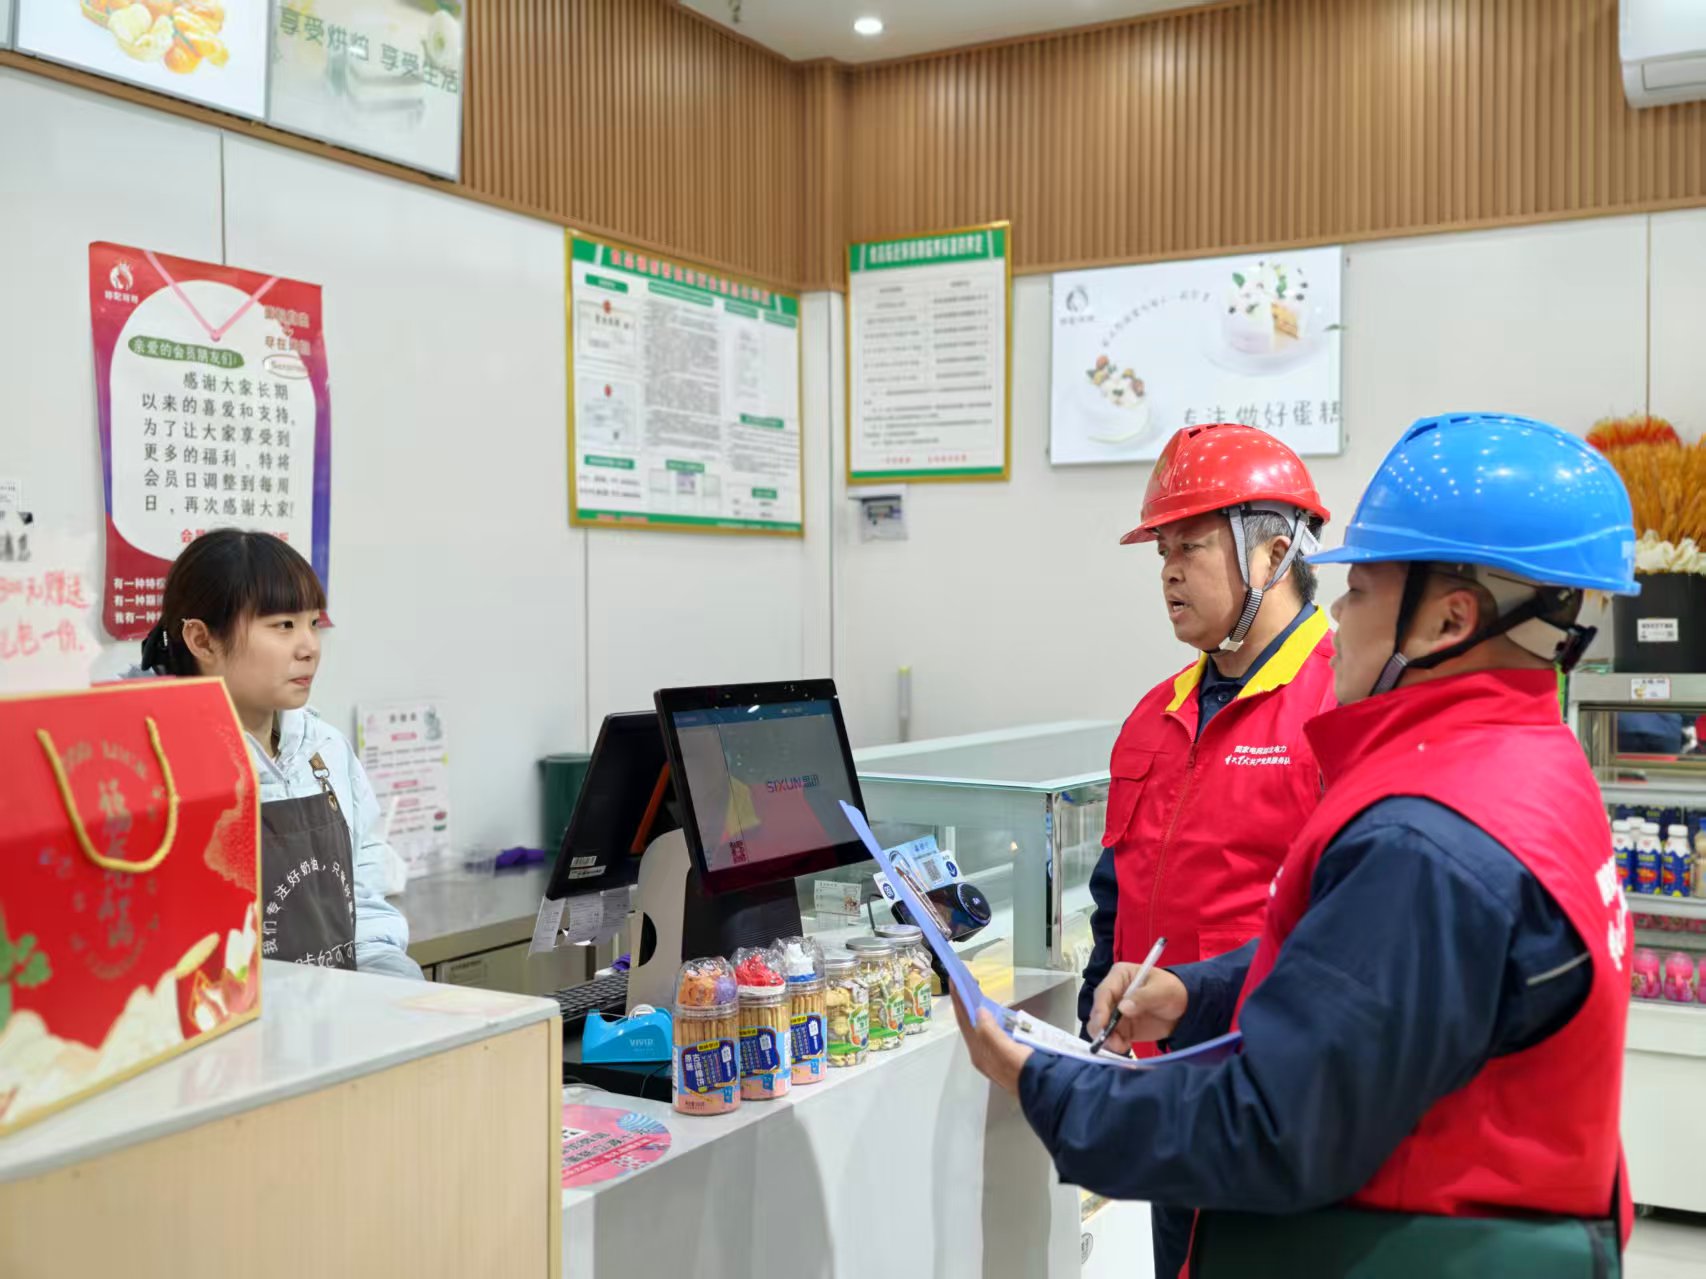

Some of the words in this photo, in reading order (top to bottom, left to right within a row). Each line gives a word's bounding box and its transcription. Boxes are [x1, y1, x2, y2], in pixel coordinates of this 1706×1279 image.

[280, 8, 370, 62] 享受烘焙
[380, 43, 459, 94] 享受生活
[183, 372, 289, 401] 感谢大家长期
[143, 418, 290, 448] 为了让大家享受到
[144, 468, 290, 495] 会员日调整到每周
[767, 778, 802, 793] SIXUN
